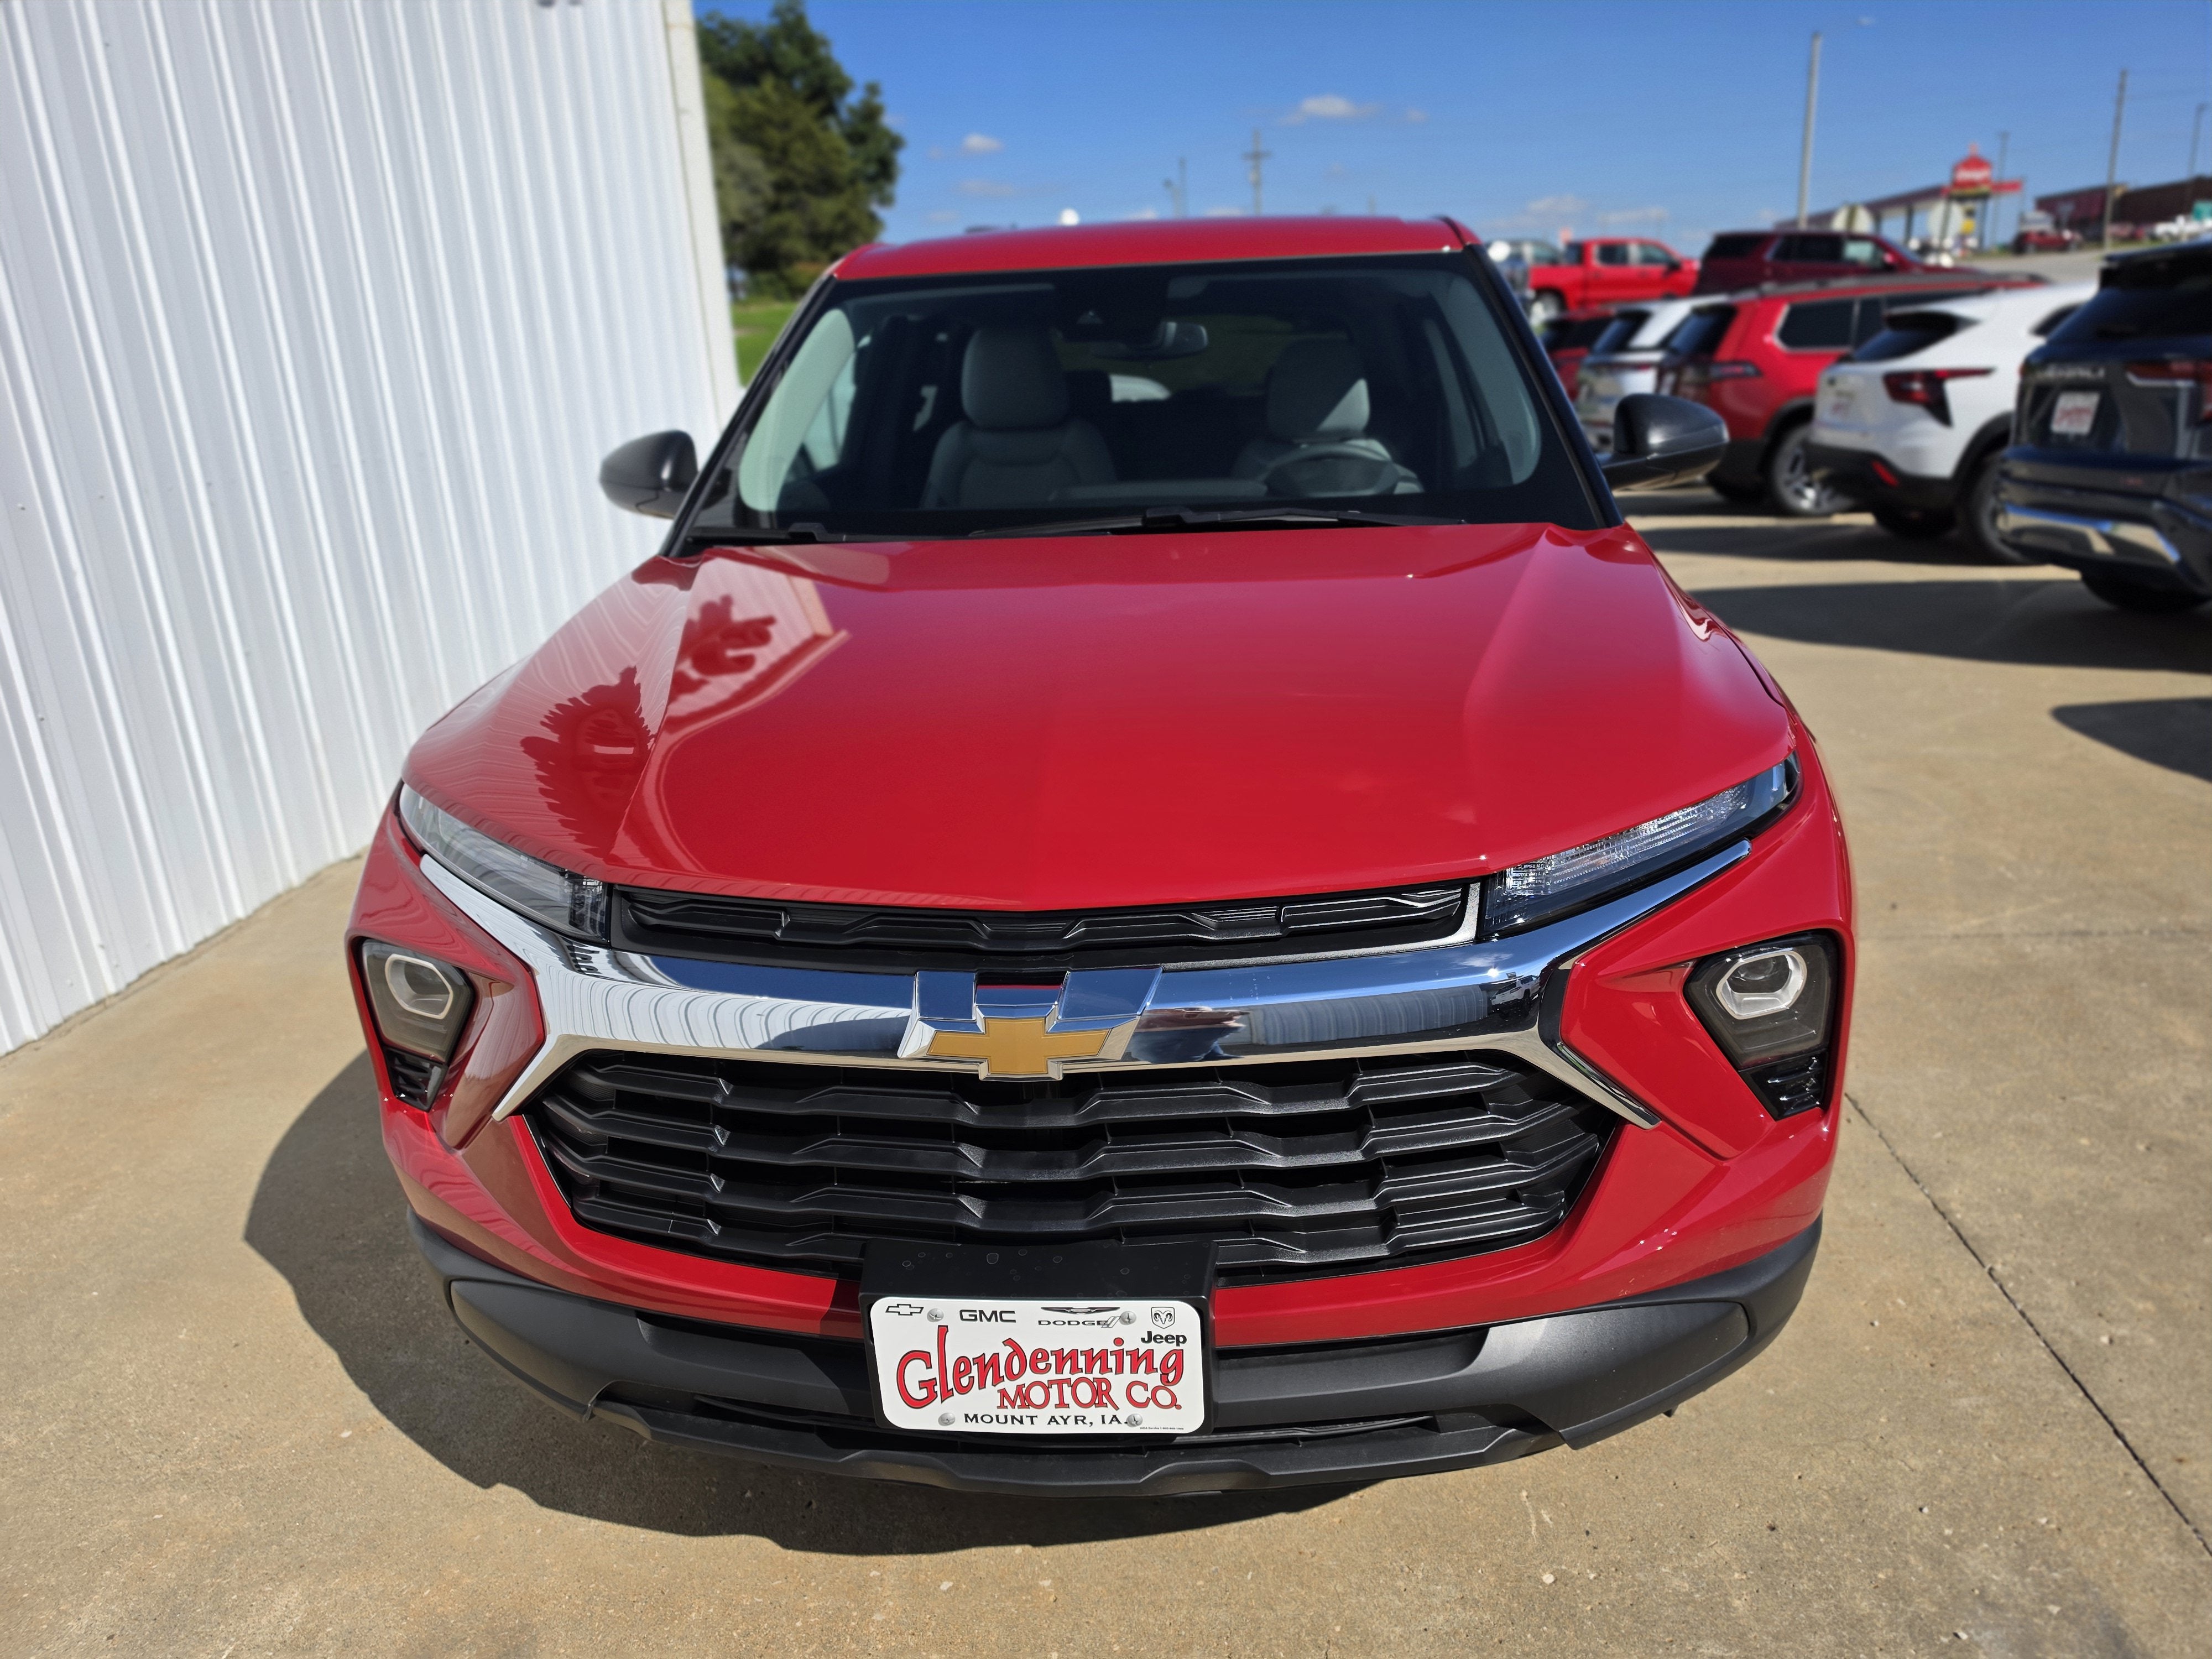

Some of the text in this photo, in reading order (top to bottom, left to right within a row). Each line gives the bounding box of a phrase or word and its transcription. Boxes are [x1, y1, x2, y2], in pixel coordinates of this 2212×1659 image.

[959, 1309, 1016, 1323] GMC
[1140, 1331, 1187, 1347] Jeep
[896, 1324, 1184, 1410] Glendenning
[997, 1376, 1182, 1411] MOTOR CO.
[964, 1413, 1128, 1427] MOUNT AYR, IA.
